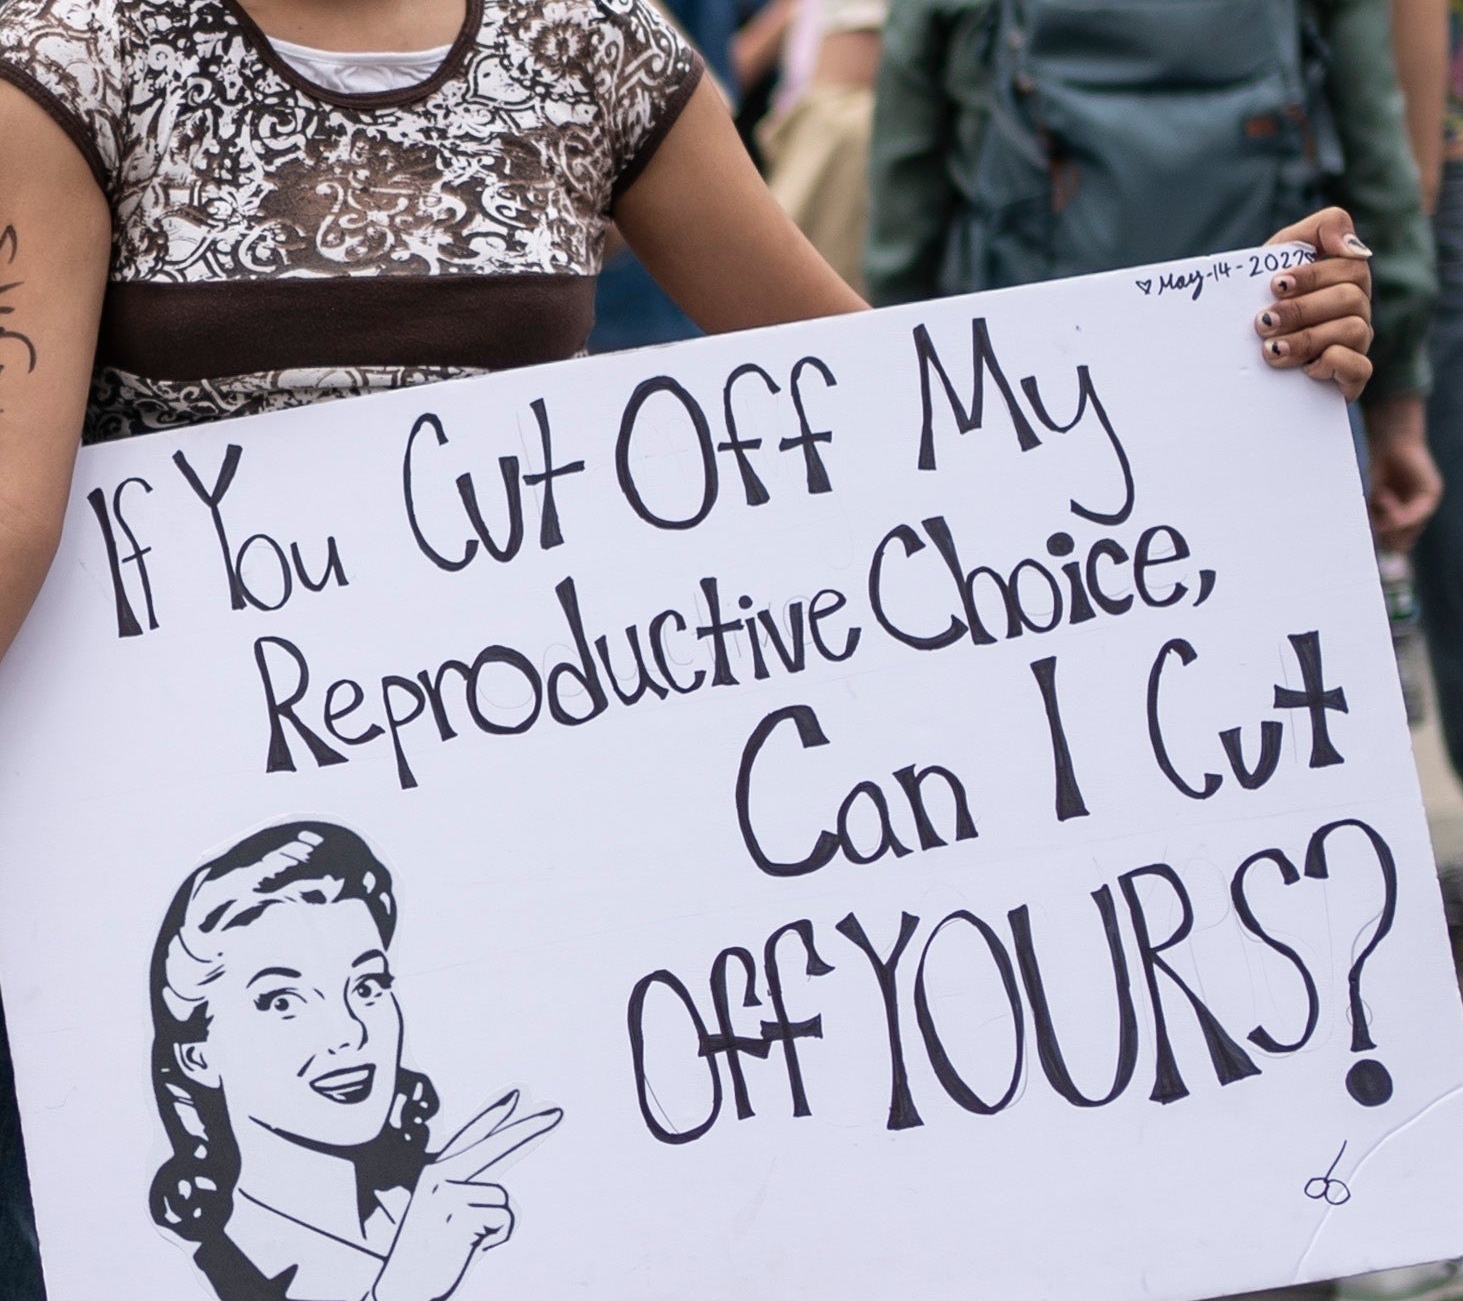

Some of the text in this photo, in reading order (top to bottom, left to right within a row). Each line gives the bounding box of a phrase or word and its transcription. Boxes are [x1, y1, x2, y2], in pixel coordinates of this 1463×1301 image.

[86, 316, 1135, 638] If You Cut Off My
[264, 516, 1217, 790] Reproductive Choice,
[734, 630, 1351, 878] Can I Cut
[835, 818, 1397, 1132] YOURS?
